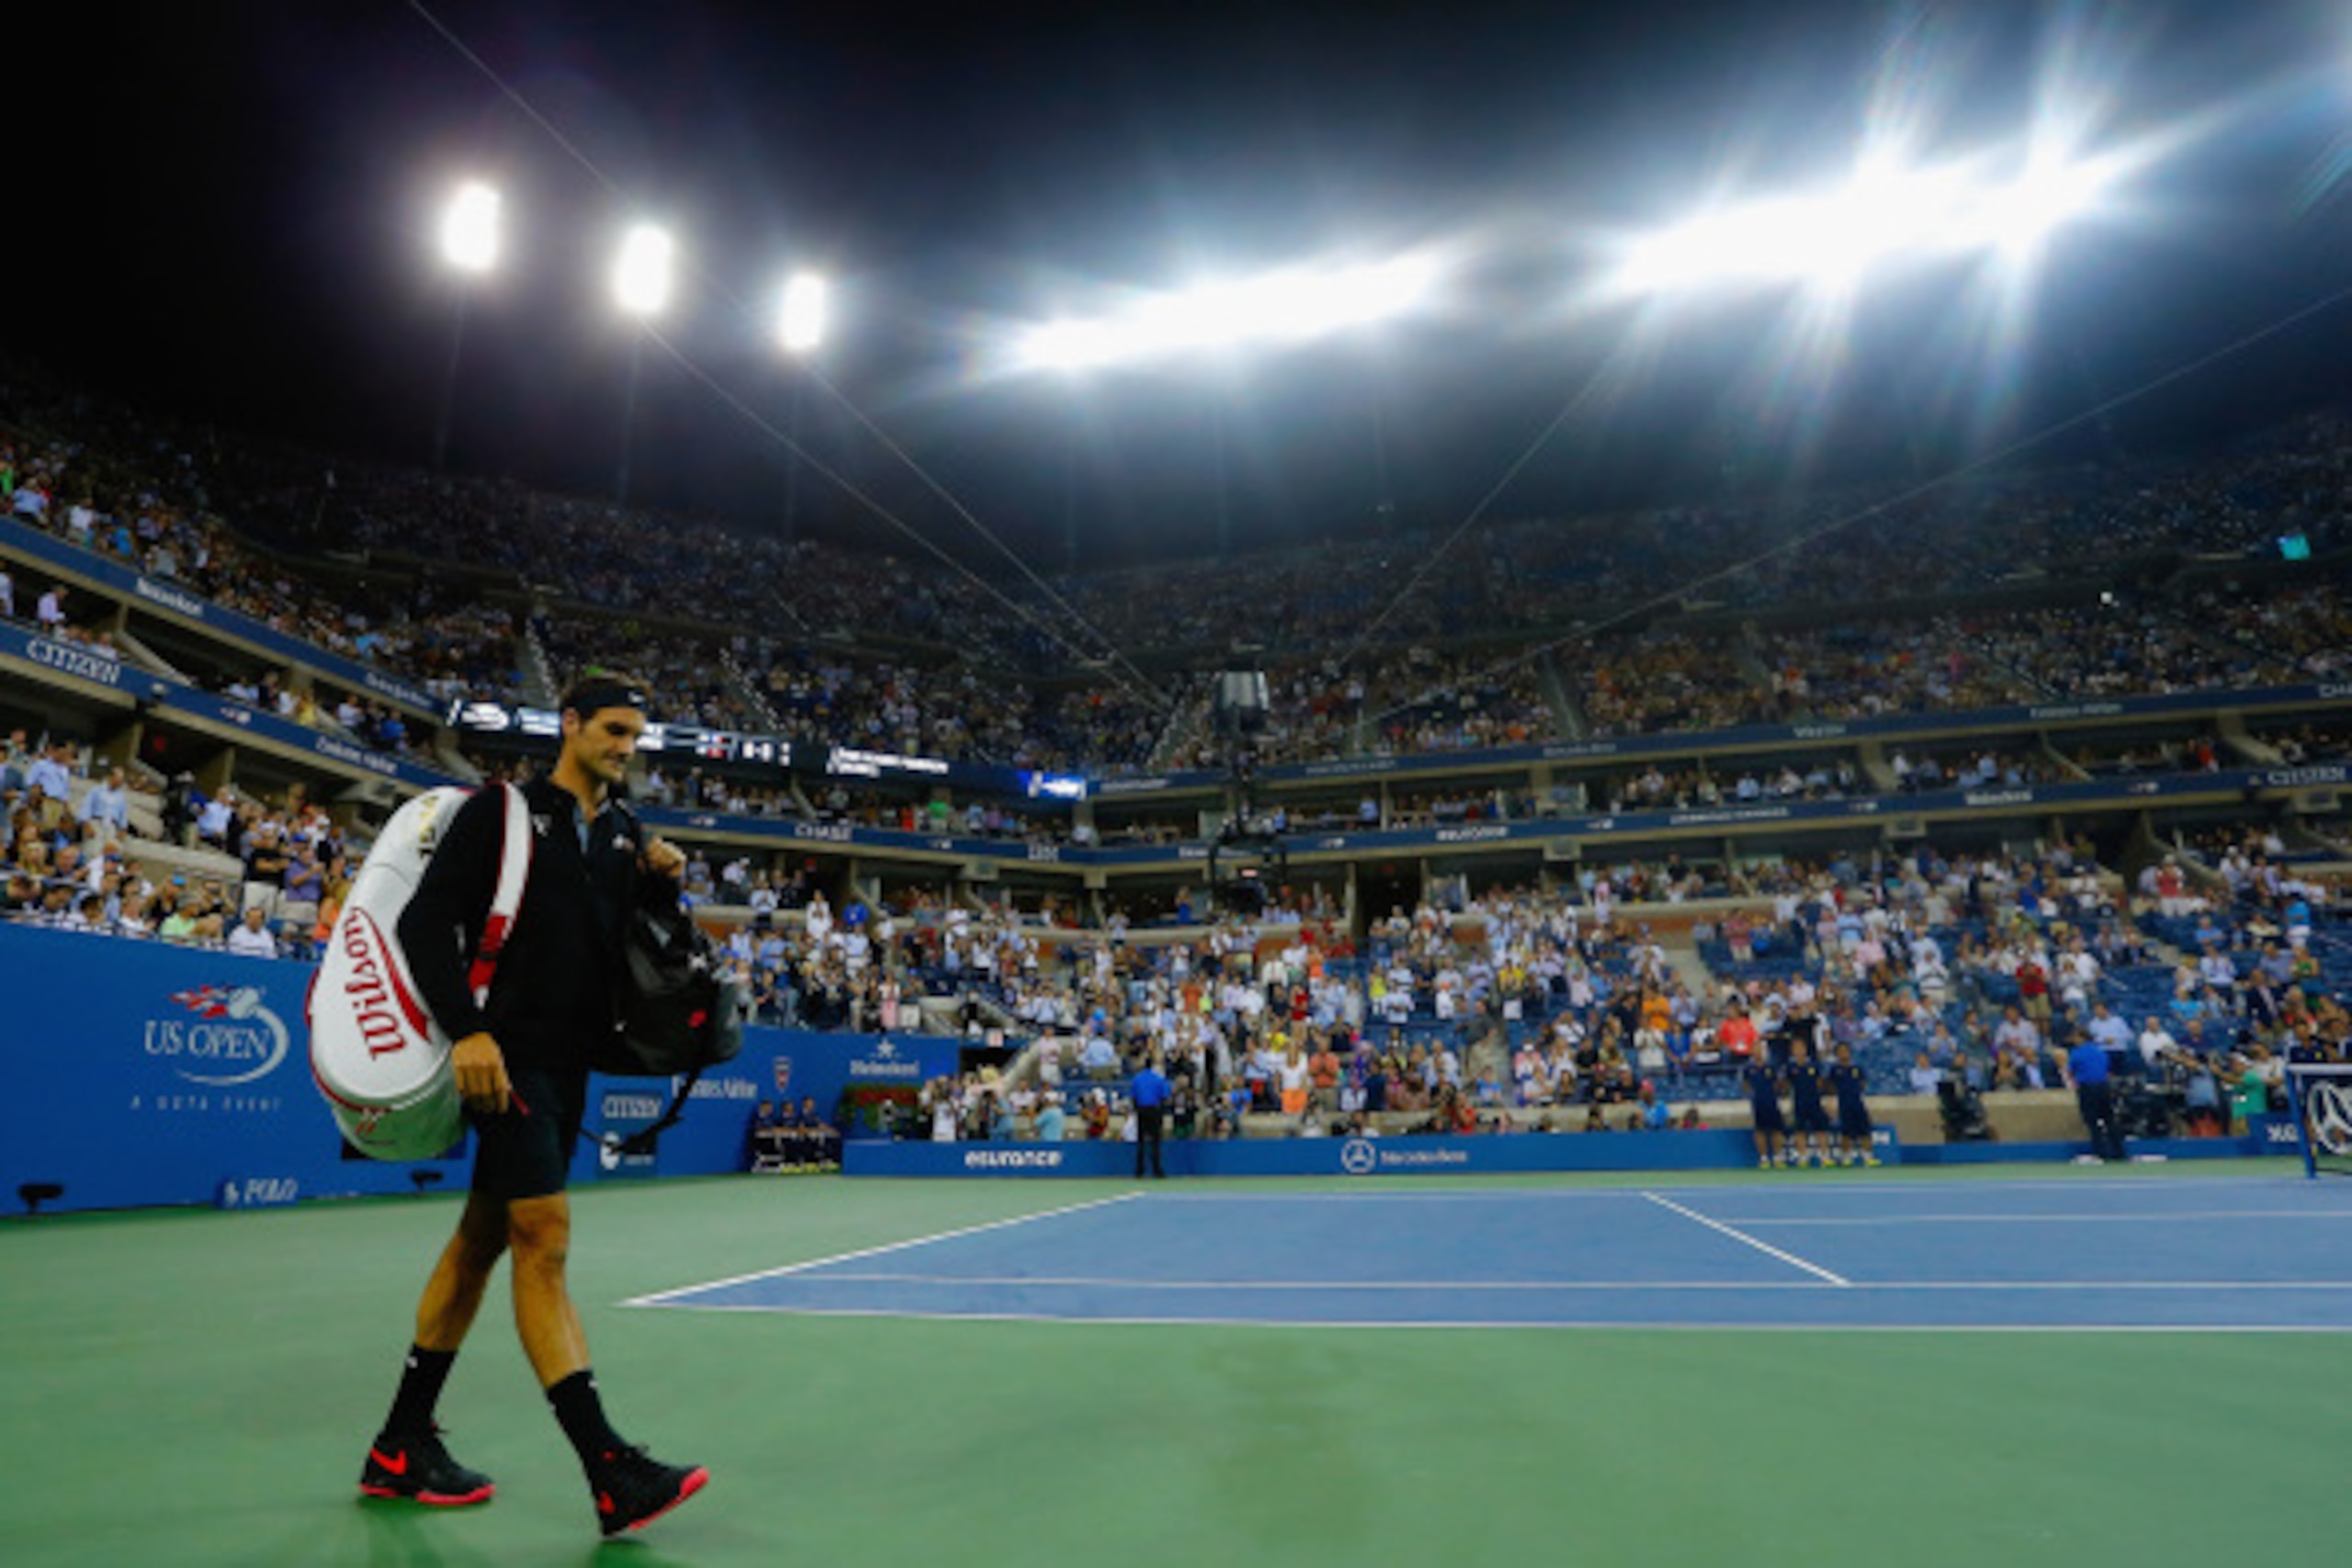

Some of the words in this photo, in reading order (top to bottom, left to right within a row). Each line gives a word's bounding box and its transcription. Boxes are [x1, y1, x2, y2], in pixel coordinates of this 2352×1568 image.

[27, 636, 120, 685] CITIZEN
[795, 822, 853, 842] CHASE
[344, 908, 407, 1061] Wilson
[144, 1019, 183, 1055] US
[188, 1022, 270, 1059] OPEN
[850, 1058, 920, 1077] Heineken
[602, 1092, 662, 1119] CITIZEN
[965, 1151, 1063, 1168] esurance
[243, 1178, 299, 1201] POLO
